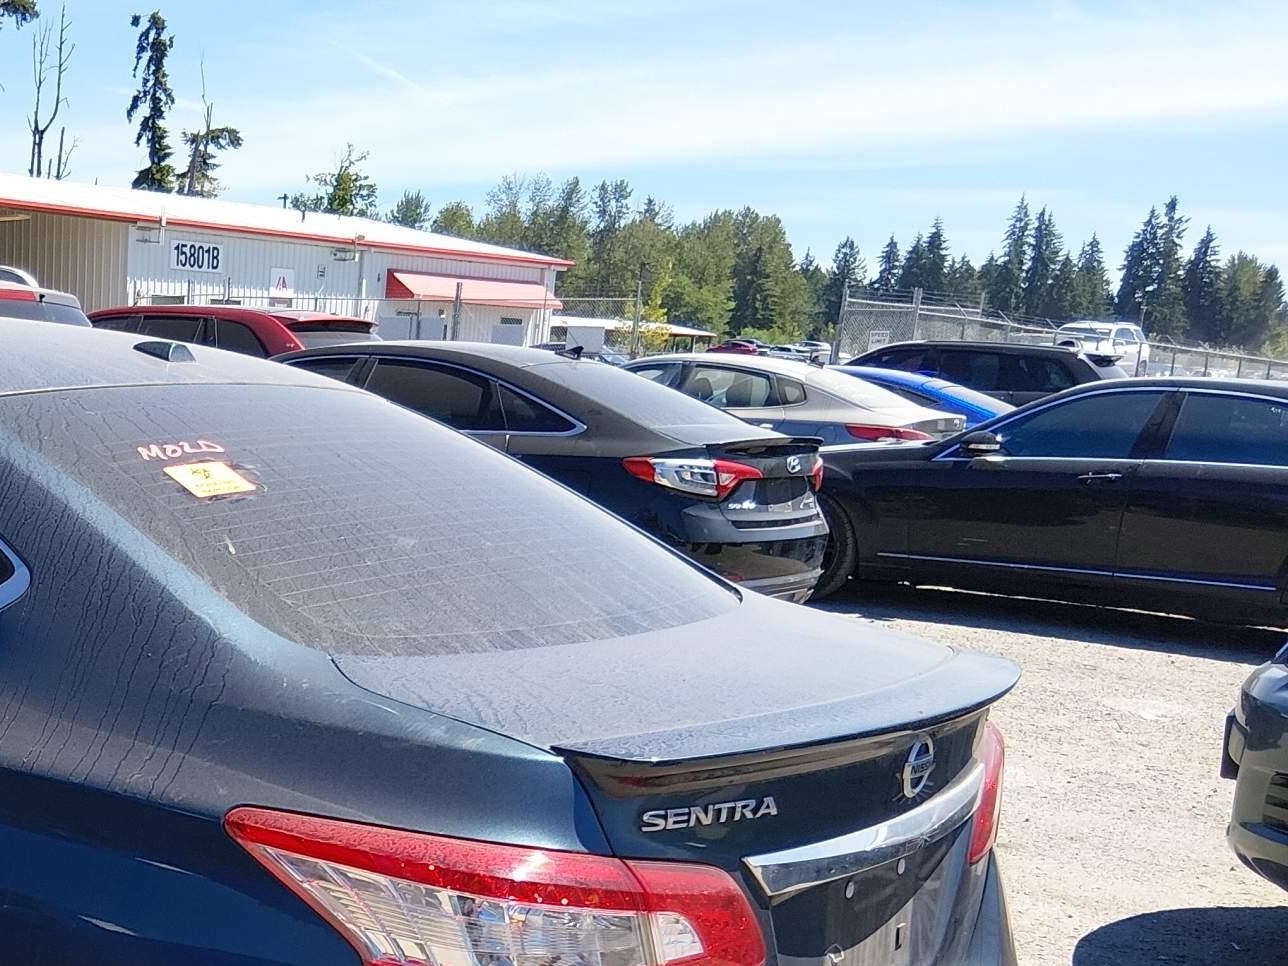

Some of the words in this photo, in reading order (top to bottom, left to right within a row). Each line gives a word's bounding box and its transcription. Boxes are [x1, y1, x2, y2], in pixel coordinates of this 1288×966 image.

[174, 242, 220, 270] 15801B
[136, 439, 225, 461] MOLD
[641, 796, 778, 832] SENTRA
